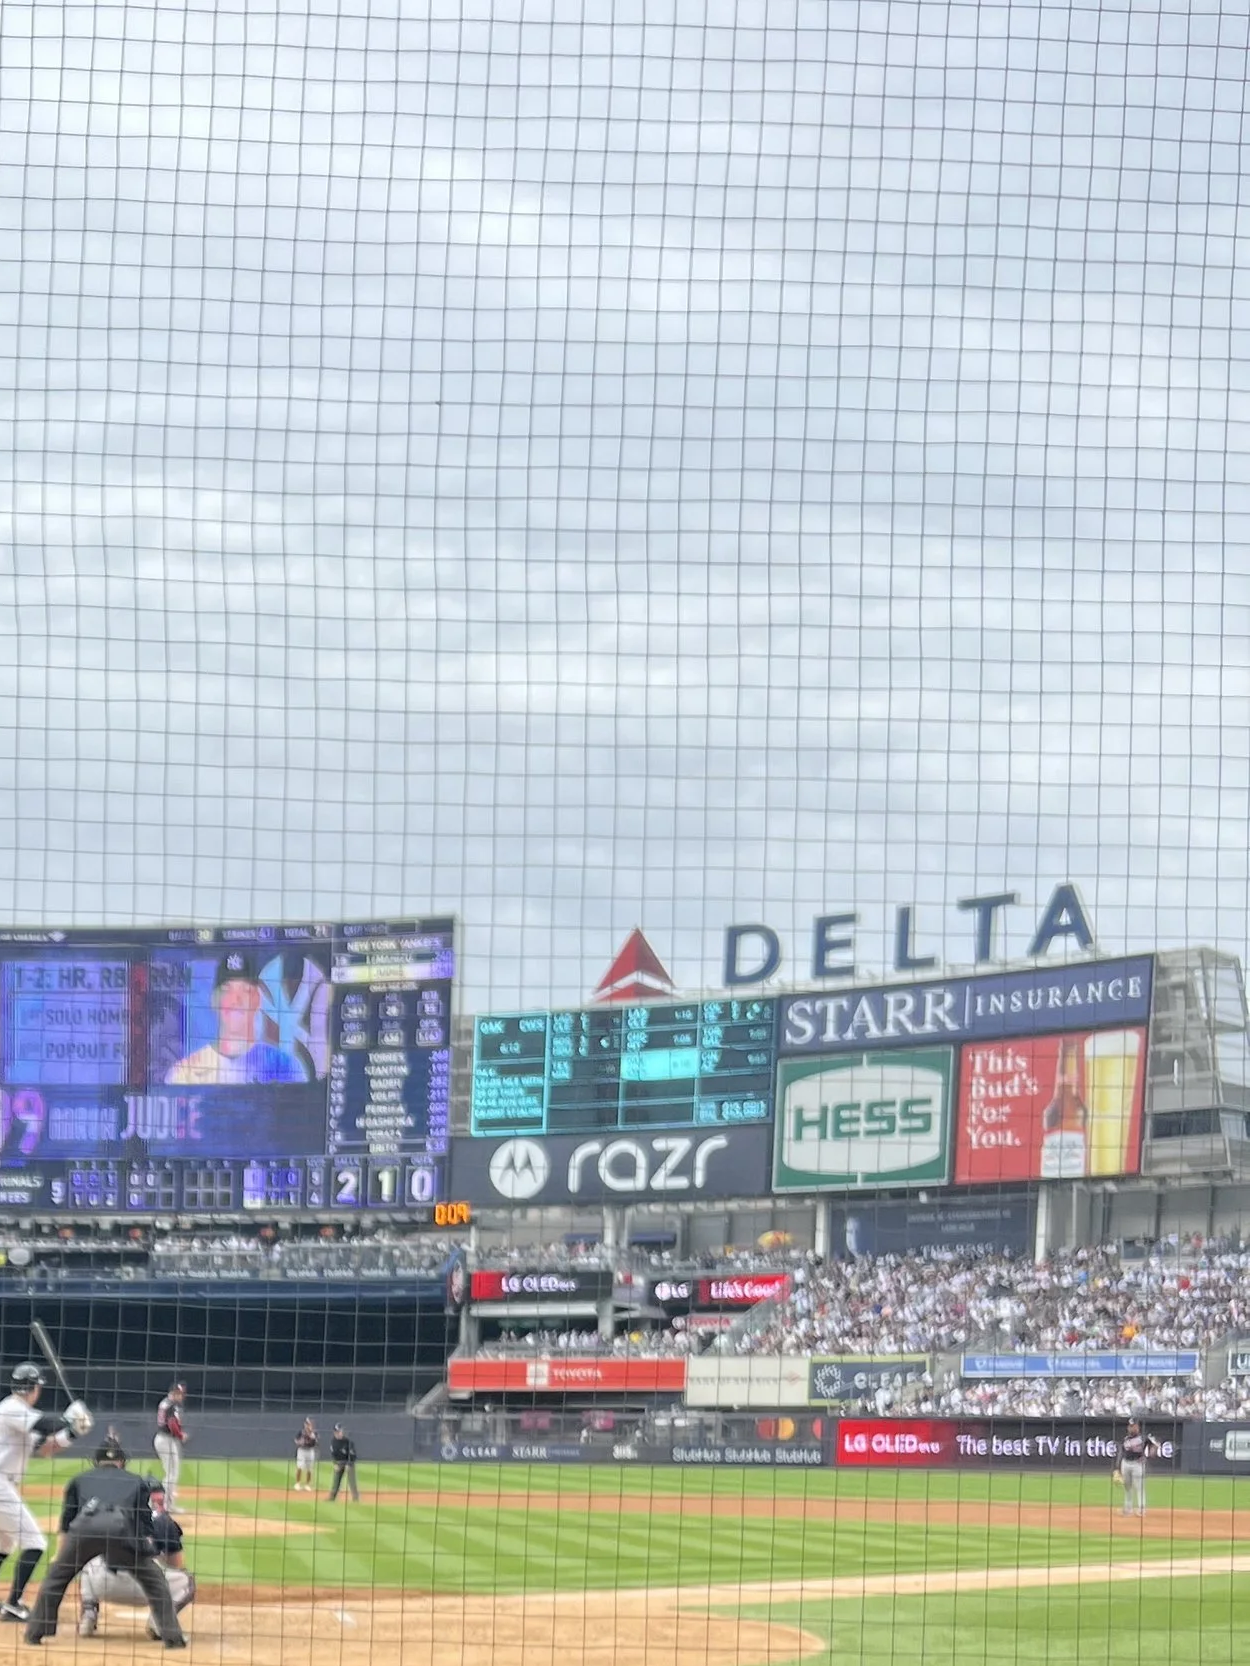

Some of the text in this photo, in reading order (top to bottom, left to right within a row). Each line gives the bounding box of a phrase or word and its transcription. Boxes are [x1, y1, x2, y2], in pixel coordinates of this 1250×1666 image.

[347, 937, 443, 952] NEW YORK YANKEES
[724, 881, 1095, 987] DELTA
[46, 1008, 83, 1026] SOLO
[785, 975, 1144, 1045] STARR INSURANCE
[480, 1018, 545, 1035] OAK CWS
[45, 1043, 109, 1061] POPOUT
[369, 1052, 406, 1064] TORRES
[968, 1047, 1028, 1075] This
[364, 1065, 409, 1077] STANTON
[969, 1072, 1039, 1098] Bud's
[120, 1095, 205, 1140] JUDGE
[793, 1098, 933, 1142] HESS
[968, 1101, 1012, 1125] For
[369, 1142, 399, 1154] BRITO
[965, 1124, 1023, 1150] You.
[567, 1133, 729, 1193] razr
[337, 1168, 433, 1204] 2 1 0
[434, 1203, 471, 1226] 0:09
[501, 1275, 557, 1293] LG OLED
[671, 1282, 689, 1299] LG
[552, 1368, 603, 1381] TOYOTA
[672, 1447, 822, 1464] StubHub StubHub StubHub
[844, 1434, 866, 1453] LG
[871, 1433, 917, 1454] OLED
[956, 1434, 987, 1456] The
[991, 1434, 1030, 1457] best
[1036, 1435, 1060, 1456] TV
[1065, 1435, 1081, 1457] in
[1086, 1436, 1117, 1458] the
